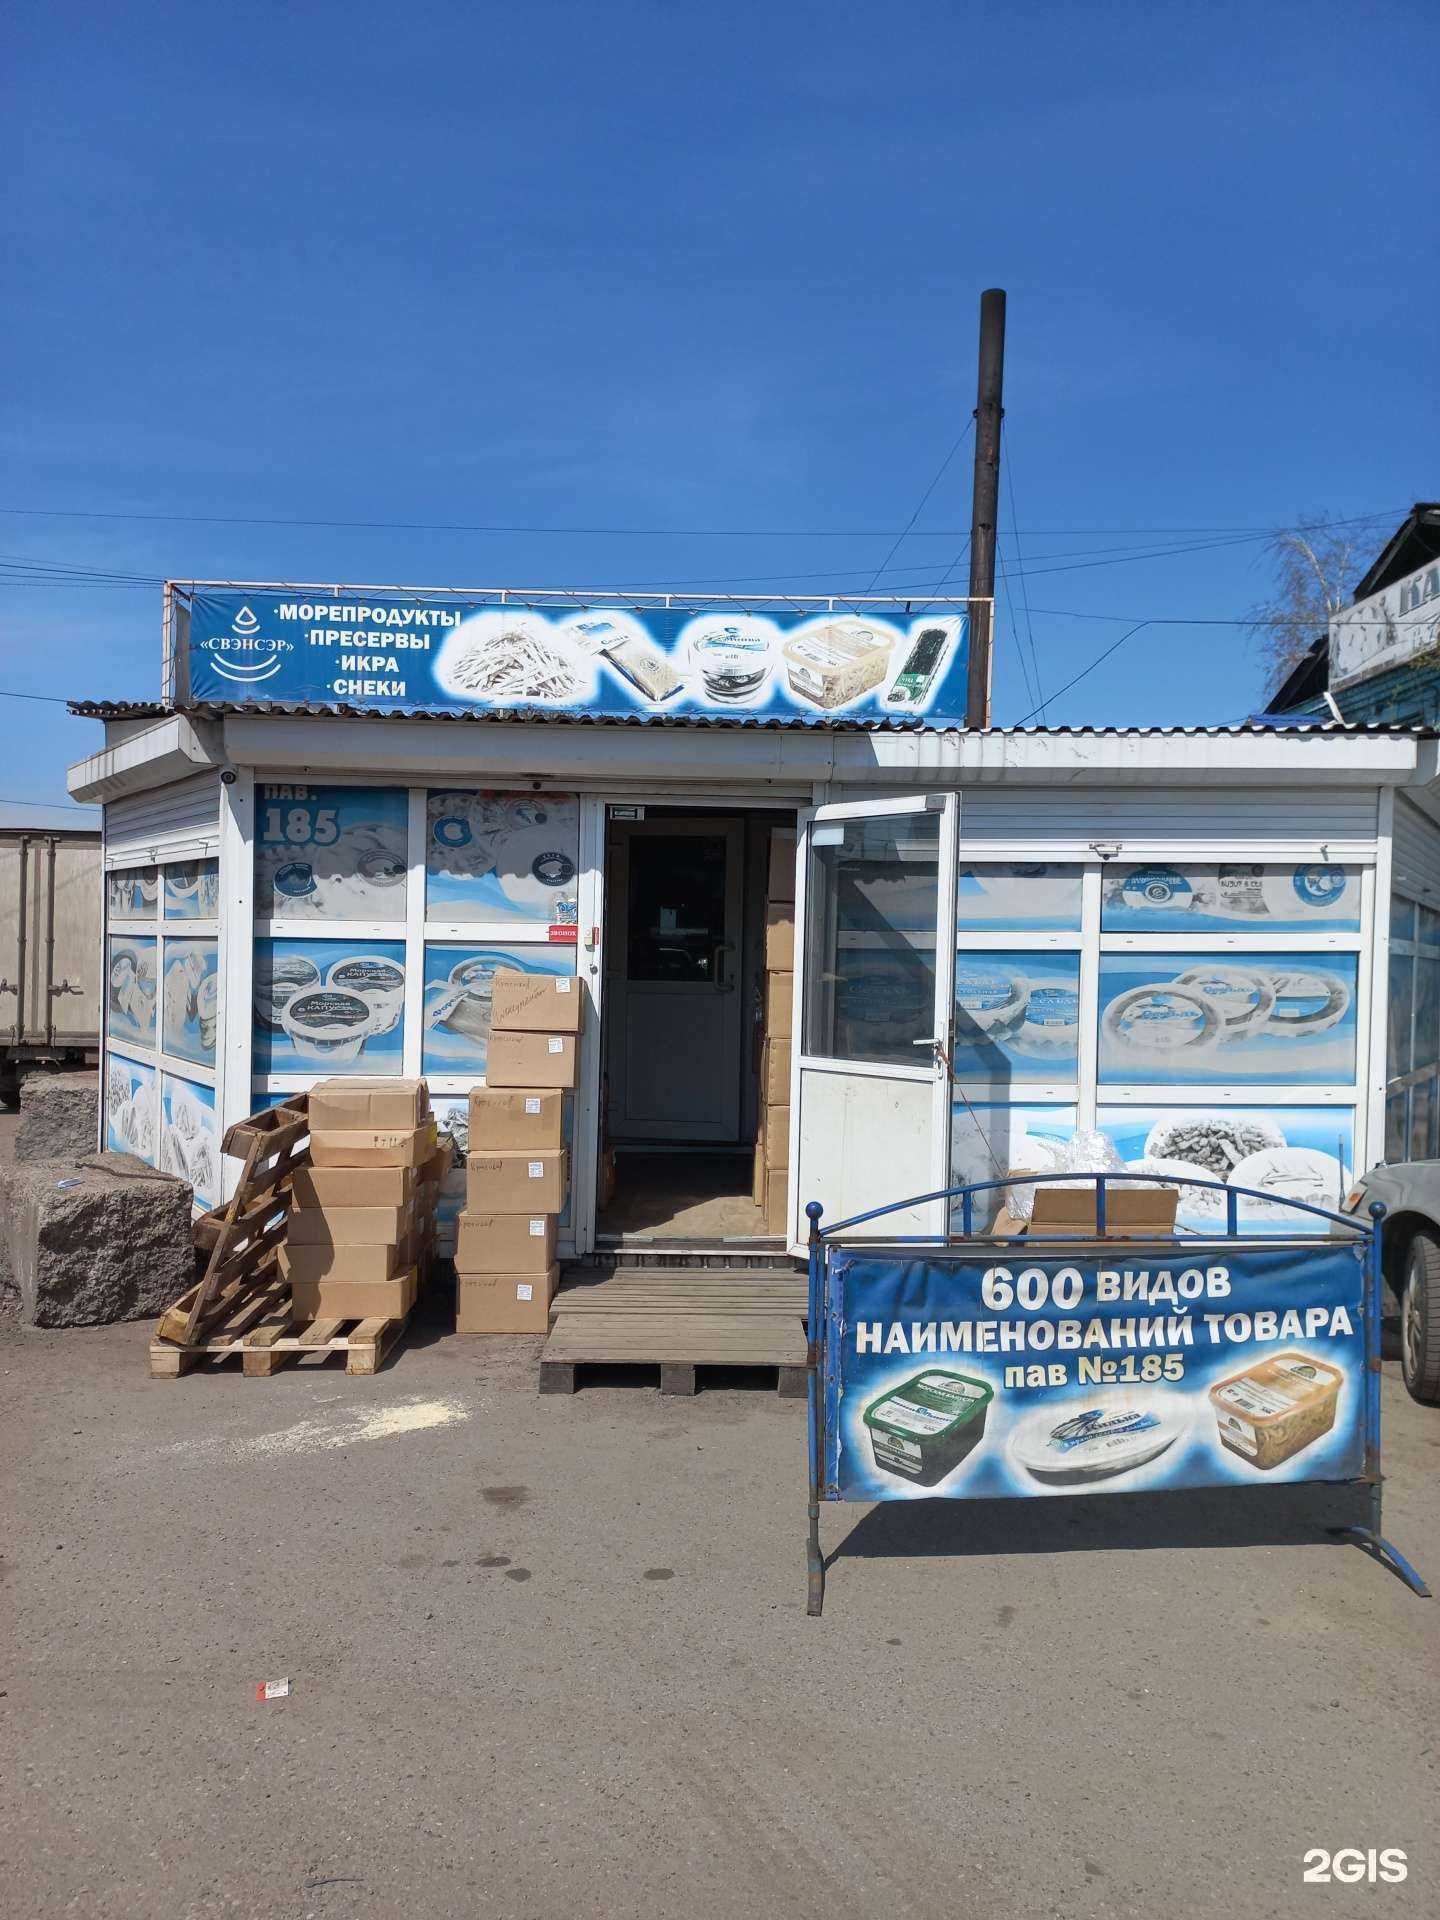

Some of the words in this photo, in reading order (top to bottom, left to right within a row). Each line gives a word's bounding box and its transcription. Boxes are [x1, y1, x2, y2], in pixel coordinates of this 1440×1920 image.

[279, 604, 461, 627] МОРЕПРОДУКТЫ
[310, 629, 430, 650] ПРЕСЕРВЫ
[341, 655, 400, 672] ИКРА
[332, 679, 406, 697] СНЕКИ
[263, 808, 337, 843] 185
[981, 1267, 1084, 1311] 600
[1096, 1266, 1232, 1306] ВИДОВ
[856, 1305, 1195, 1354] НАИМЕНОВАНИЙ
[1203, 1306, 1354, 1344] ТОВАРА
[1004, 1363, 1068, 1389] пав
[1078, 1353, 1186, 1385] №185
